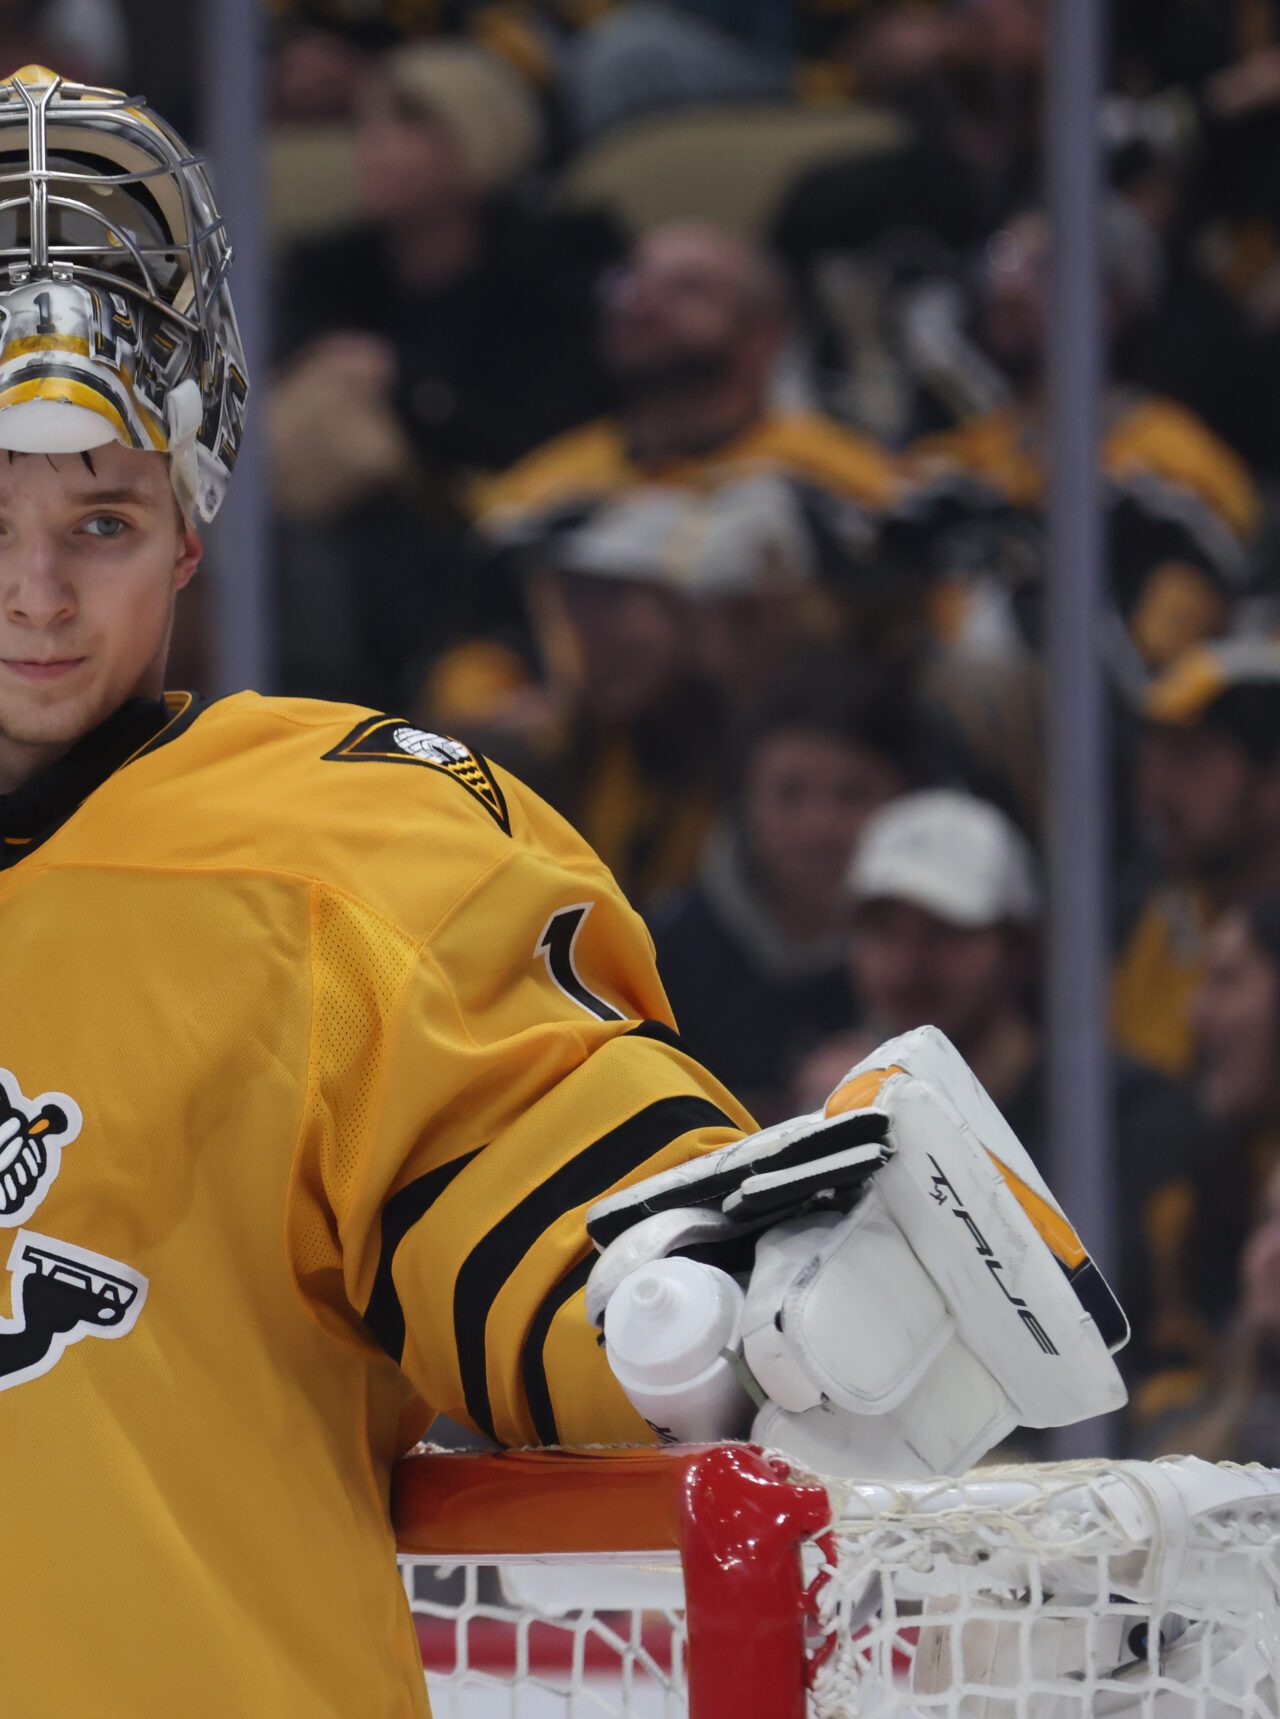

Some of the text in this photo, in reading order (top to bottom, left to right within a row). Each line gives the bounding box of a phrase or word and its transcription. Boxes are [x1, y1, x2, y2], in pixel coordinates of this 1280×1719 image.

[33, 292, 56, 334] 1
[533, 901, 629, 1021] 1
[926, 1152, 1060, 1356] TRUE
